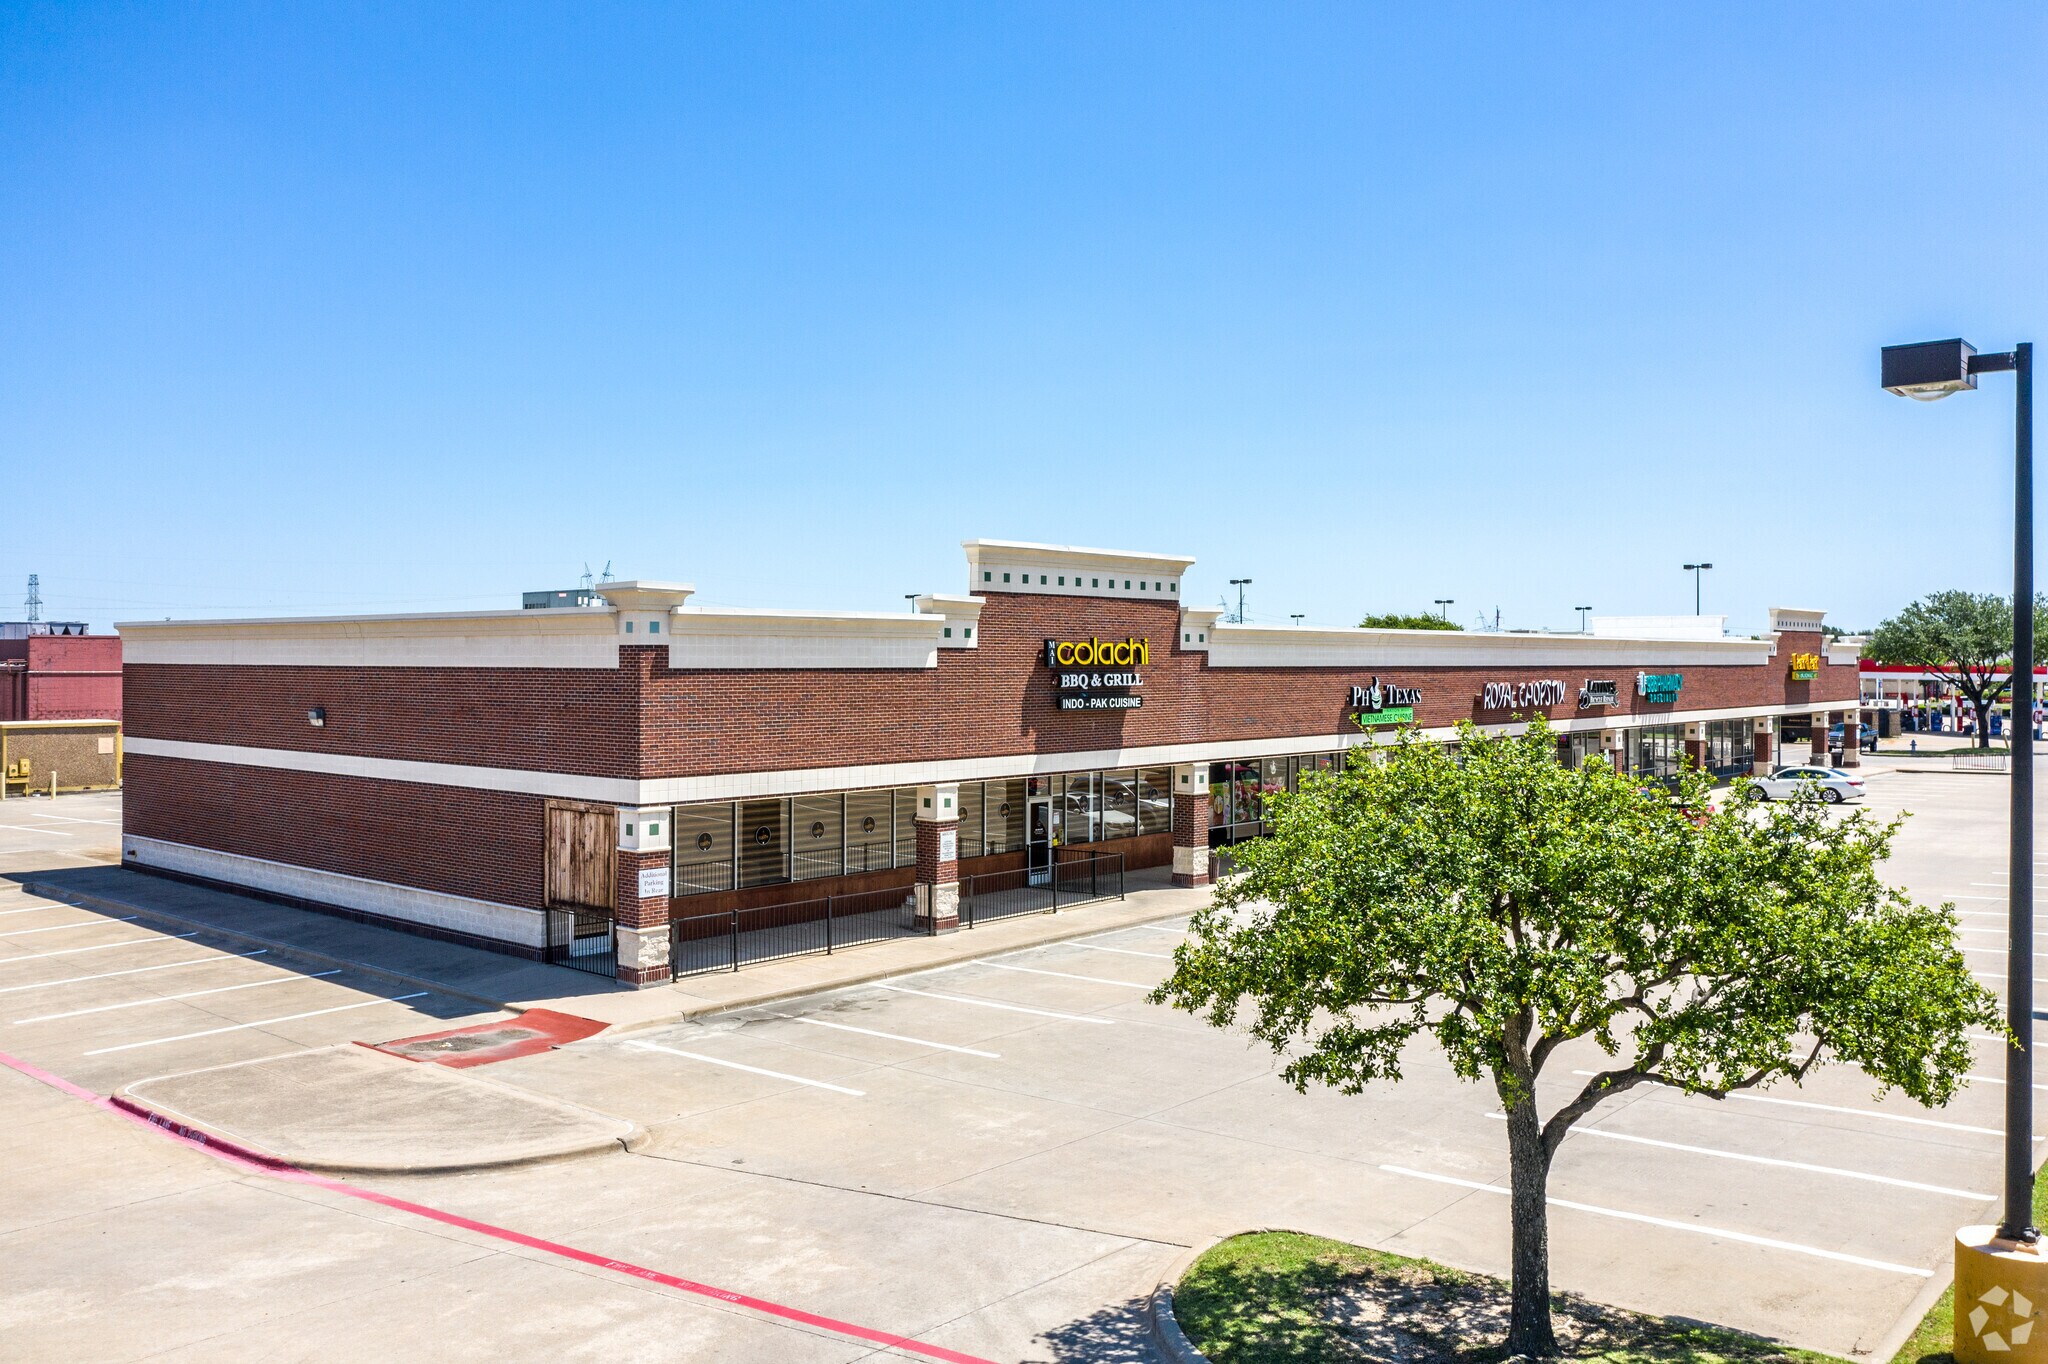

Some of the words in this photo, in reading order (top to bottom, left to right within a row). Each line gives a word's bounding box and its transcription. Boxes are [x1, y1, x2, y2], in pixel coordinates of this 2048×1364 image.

[1048, 640, 1056, 665] MAI
[1056, 637, 1149, 665] colachi
[1060, 673, 1089, 690] BBQ
[1090, 673, 1102, 687] &
[1103, 673, 1144, 687] GRILL
[1062, 698, 1084, 709] INDO
[1090, 698, 1108, 708] PAK
[1109, 697, 1141, 708] CUISINE
[1483, 682, 1517, 710] ROYAL
[1518, 679, 1566, 708] CHOPSTIX
[1363, 713, 1393, 723] VIETNAMESE
[640, 871, 667, 879] Additional
